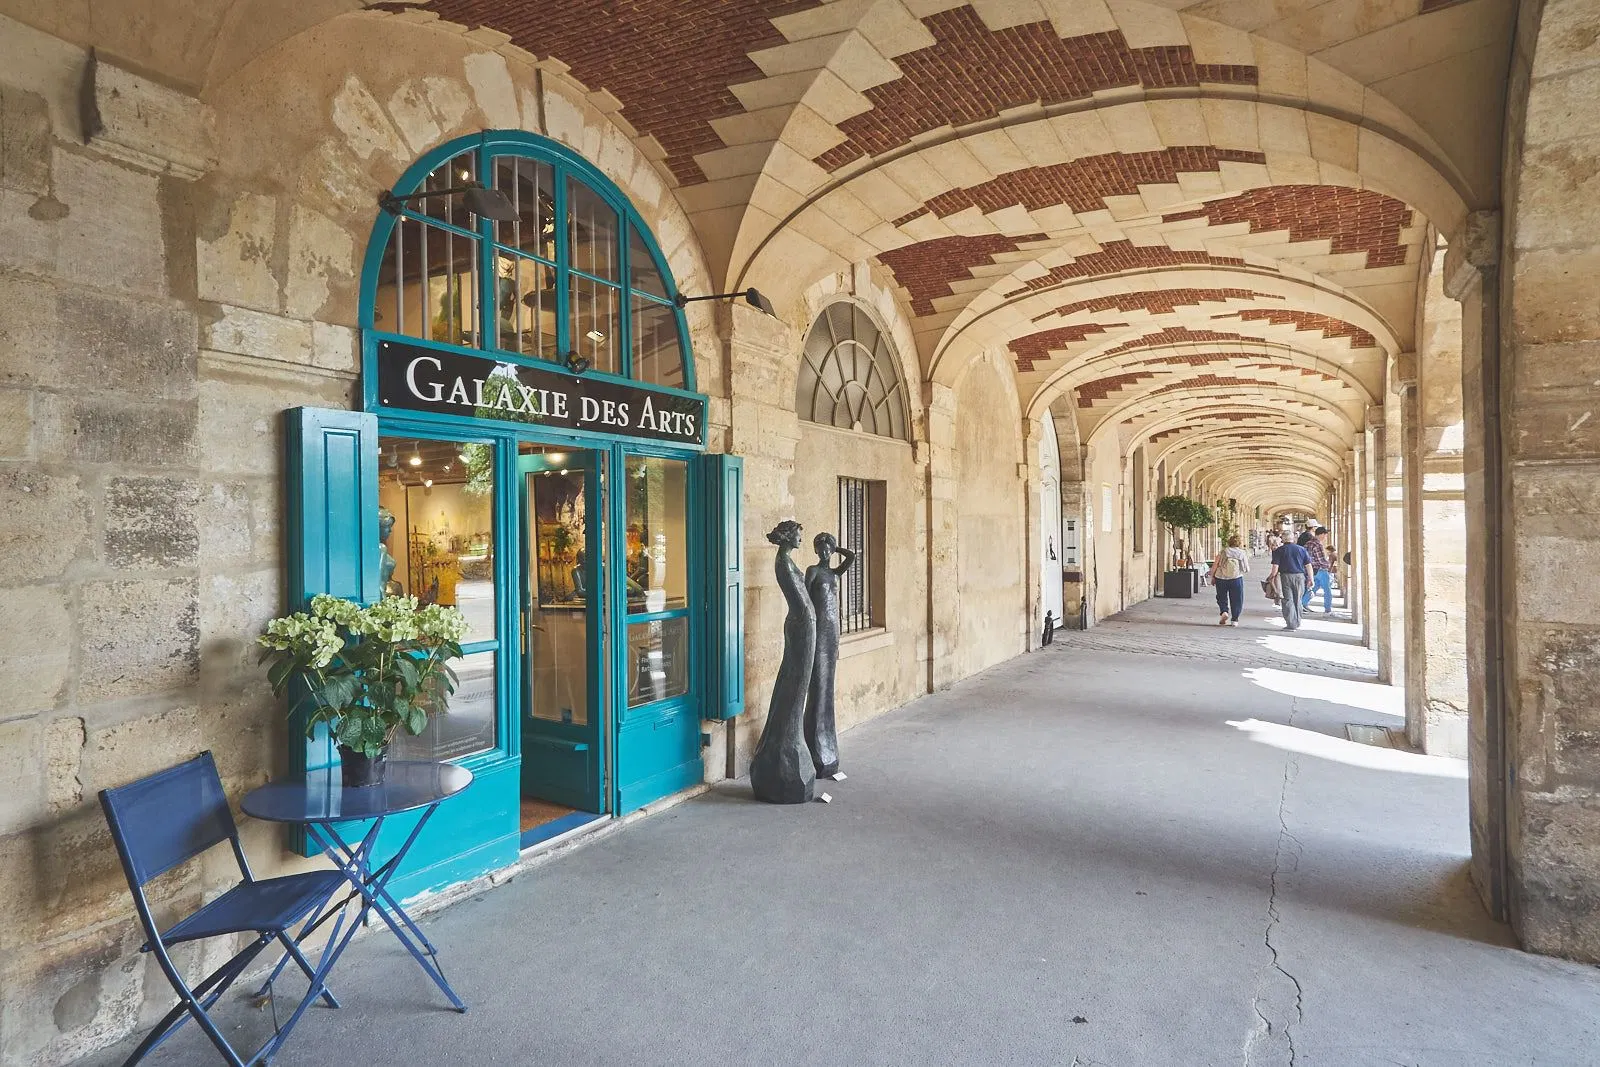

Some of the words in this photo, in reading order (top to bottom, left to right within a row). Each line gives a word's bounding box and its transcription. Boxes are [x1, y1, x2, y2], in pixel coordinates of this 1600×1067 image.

[406, 357, 568, 418] GALAXIE
[580, 397, 628, 427] DES
[637, 396, 694, 436] ARTS
